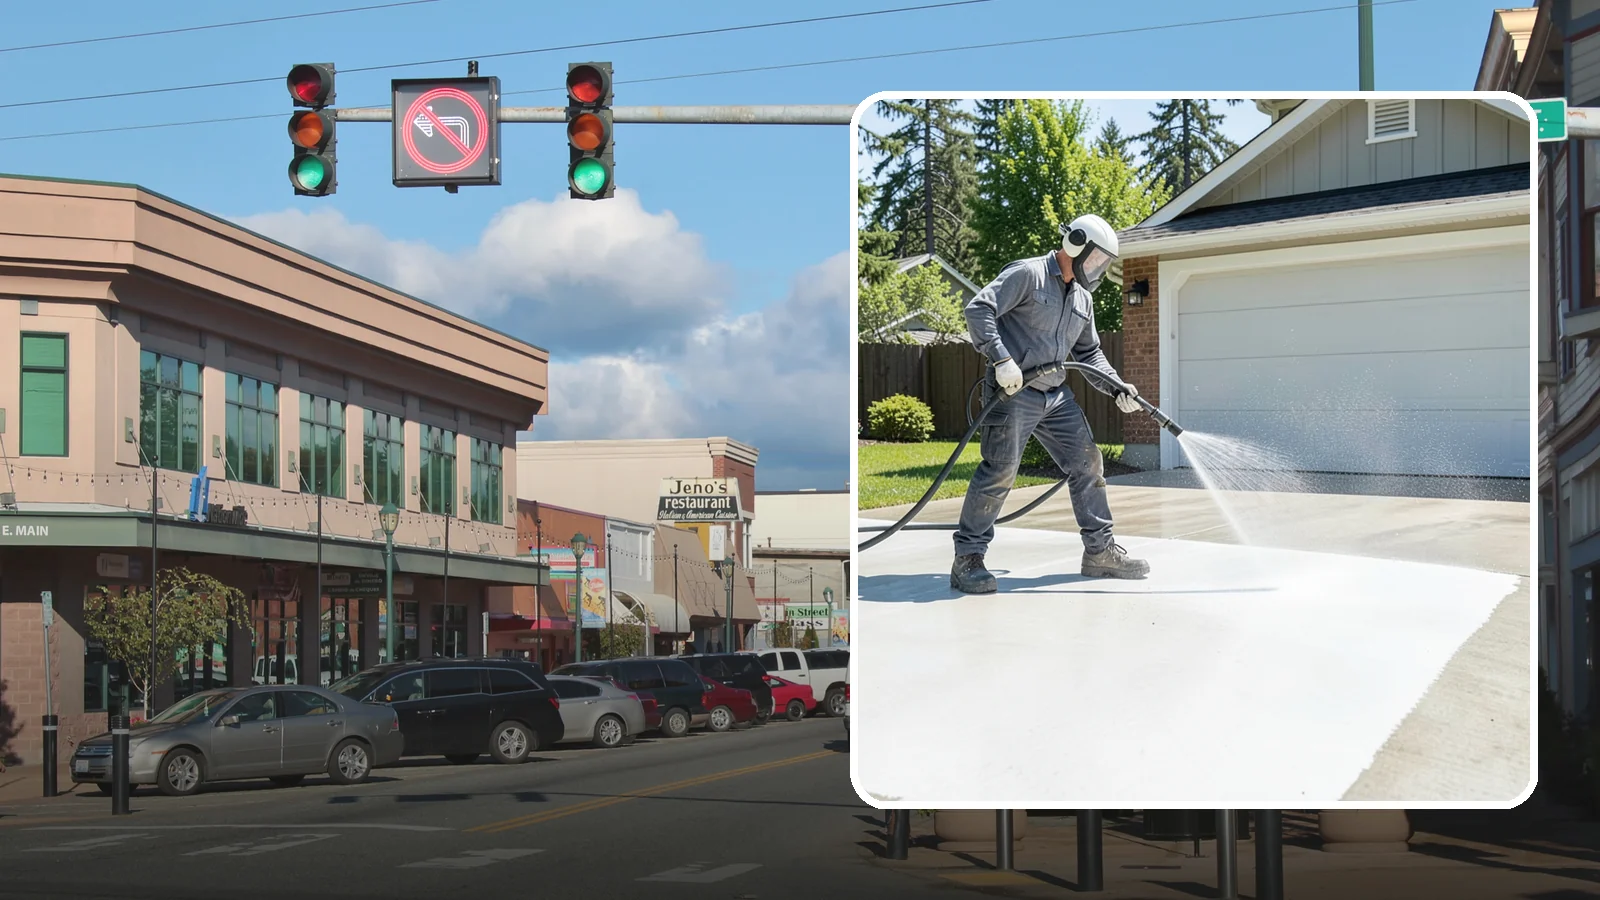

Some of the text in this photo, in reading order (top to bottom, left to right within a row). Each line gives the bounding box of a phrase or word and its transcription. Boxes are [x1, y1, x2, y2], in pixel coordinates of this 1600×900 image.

[670, 480, 727, 494] Jeno's
[665, 497, 731, 509] restaurant
[659, 510, 681, 519] Italian
[686, 510, 714, 519] American
[715, 510, 737, 519] Cuisine
[2, 525, 49, 536] E. MAIN
[785, 607, 828, 617] in Street
